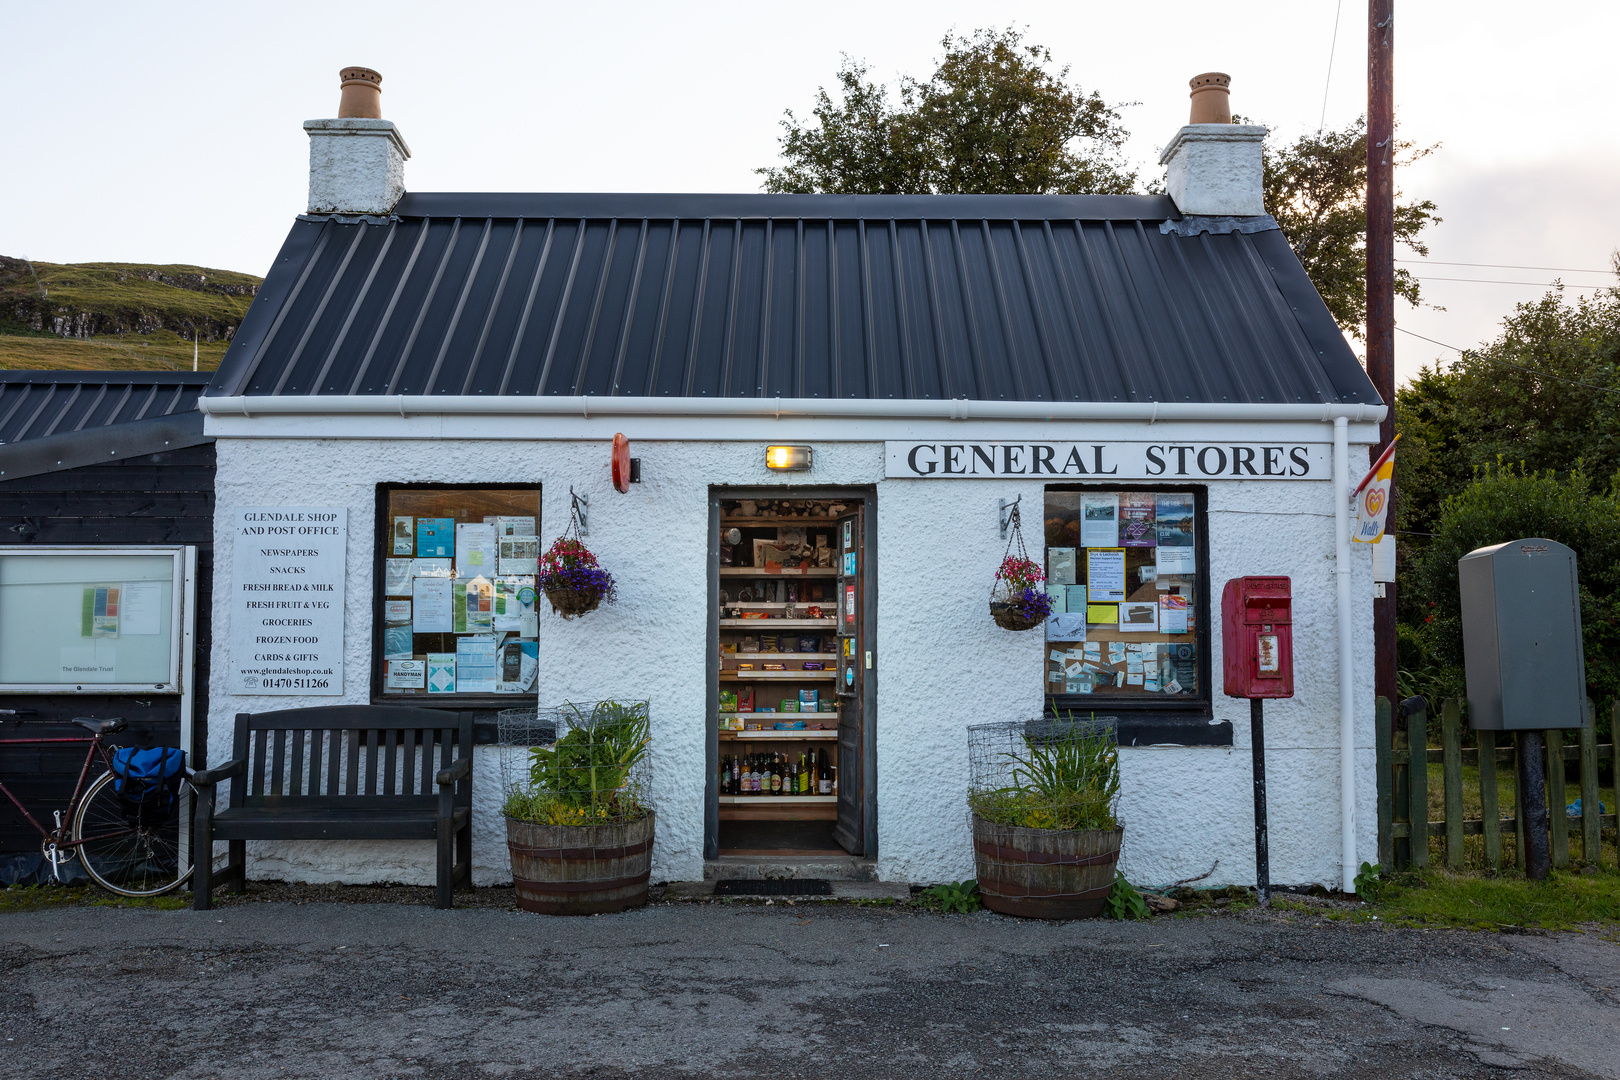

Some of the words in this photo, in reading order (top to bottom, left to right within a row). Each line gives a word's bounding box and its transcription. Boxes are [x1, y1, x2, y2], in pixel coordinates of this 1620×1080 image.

[907, 444, 1118, 475] GENERAL
[1145, 445, 1310, 476] STORES
[244, 513, 304, 522] GLENDALE
[307, 513, 337, 522] SHOP
[241, 527, 264, 535] AND
[268, 527, 295, 535] POST
[298, 527, 339, 535] OFFICE
[1361, 521, 1379, 536] Wall's
[1247, 582, 1264, 590] POST
[246, 601, 274, 609] FRESH
[276, 601, 302, 609] FRUIT
[312, 601, 329, 609] VEG
[256, 636, 292, 644] FROZEN
[293, 636, 318, 644] FOOD
[240, 668, 333, 676] www.glendaleshop.co.uk
[263, 679, 292, 688] 01470
[294, 679, 329, 688] 511266
